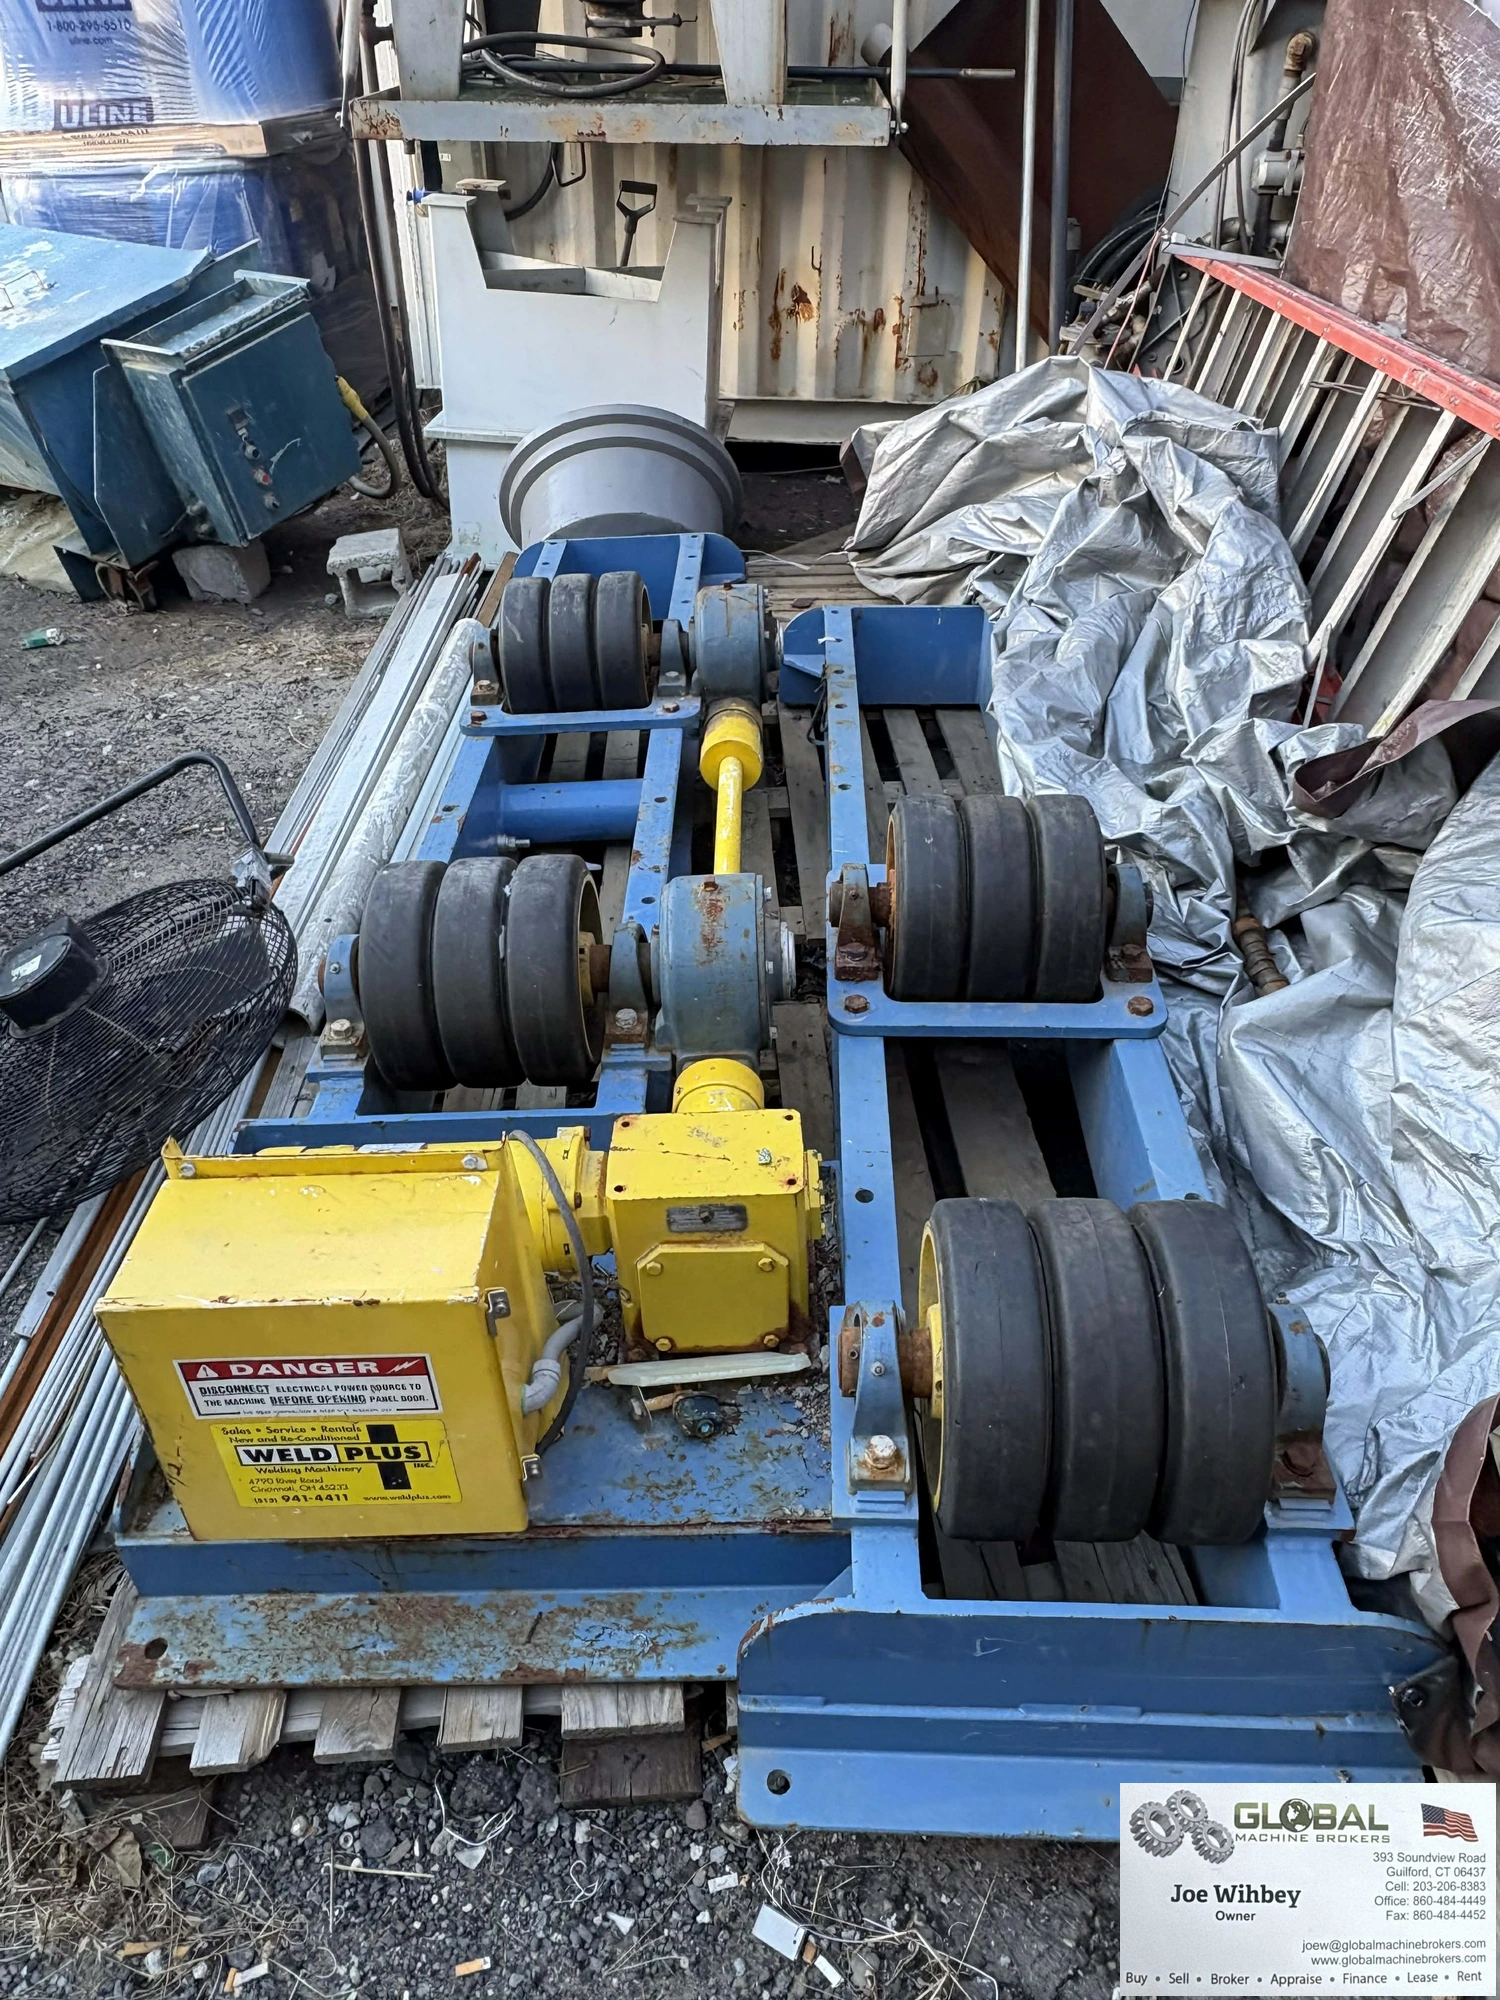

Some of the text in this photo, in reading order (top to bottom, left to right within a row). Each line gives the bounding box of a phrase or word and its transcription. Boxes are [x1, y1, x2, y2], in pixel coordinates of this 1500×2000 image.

[60, 102, 148, 126] ULINE
[229, 1361, 380, 1376] DANGER
[199, 1384, 270, 1396] DISCONNECT
[275, 1384, 333, 1393] ELECTRICAL
[335, 1384, 368, 1392] POWER
[409, 1383, 422, 1391] TO
[204, 1399, 223, 1407] THE
[225, 1397, 267, 1406] MACHINE
[269, 1395, 314, 1405] BEFORE
[317, 1394, 367, 1404] OPENING
[369, 1395, 399, 1403] PANEL
[221, 1423, 362, 1436] Sales Service Rentals
[229, 1436, 254, 1444] New
[258, 1435, 278, 1443] and
[243, 1445, 422, 1463] WELD PLUS
[255, 1464, 362, 1474] Welding Machinery
[299, 1484, 317, 1492] OH
[281, 1493, 349, 1503] 941-4411
